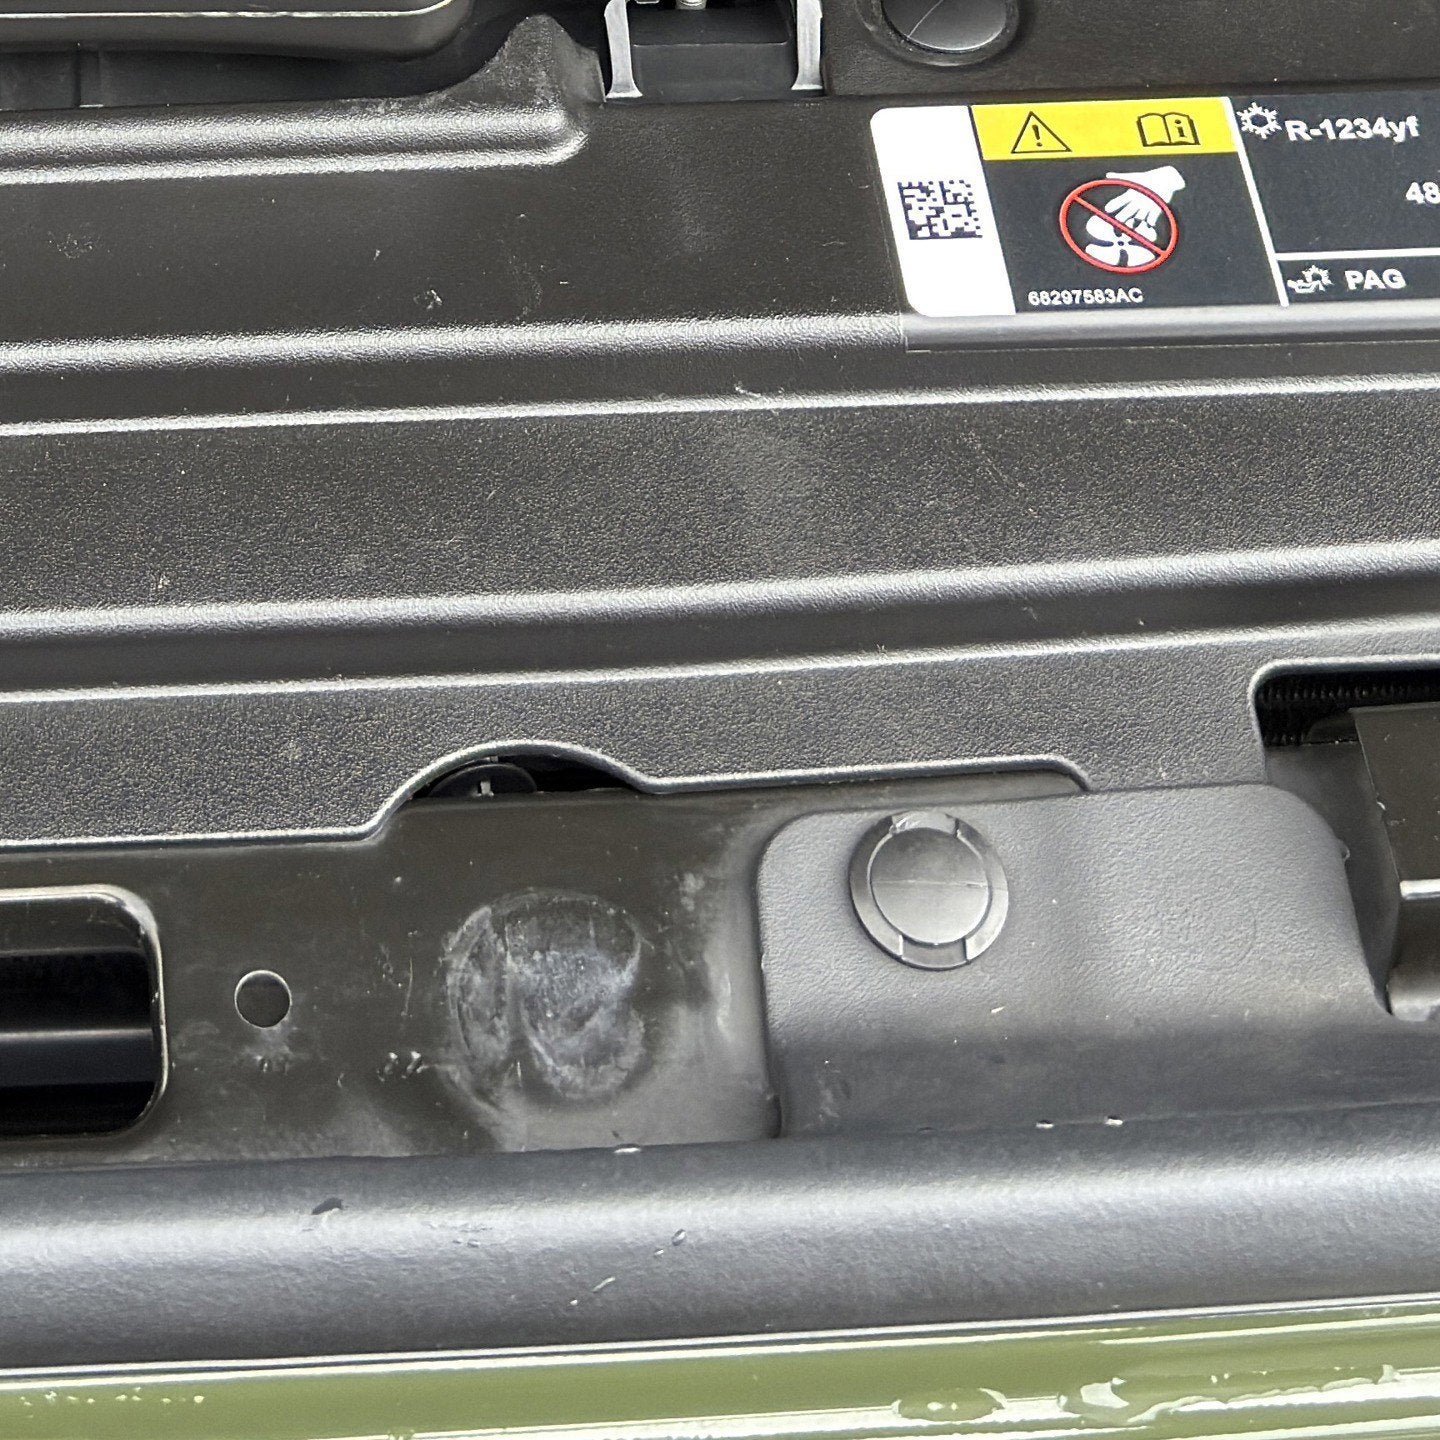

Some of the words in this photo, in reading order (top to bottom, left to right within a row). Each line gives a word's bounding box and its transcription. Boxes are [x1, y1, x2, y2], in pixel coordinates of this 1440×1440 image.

[1287, 114, 1420, 142] R-1234yf
[1344, 269, 1407, 291] PAG
[1027, 287, 1143, 307] 68297583AC
